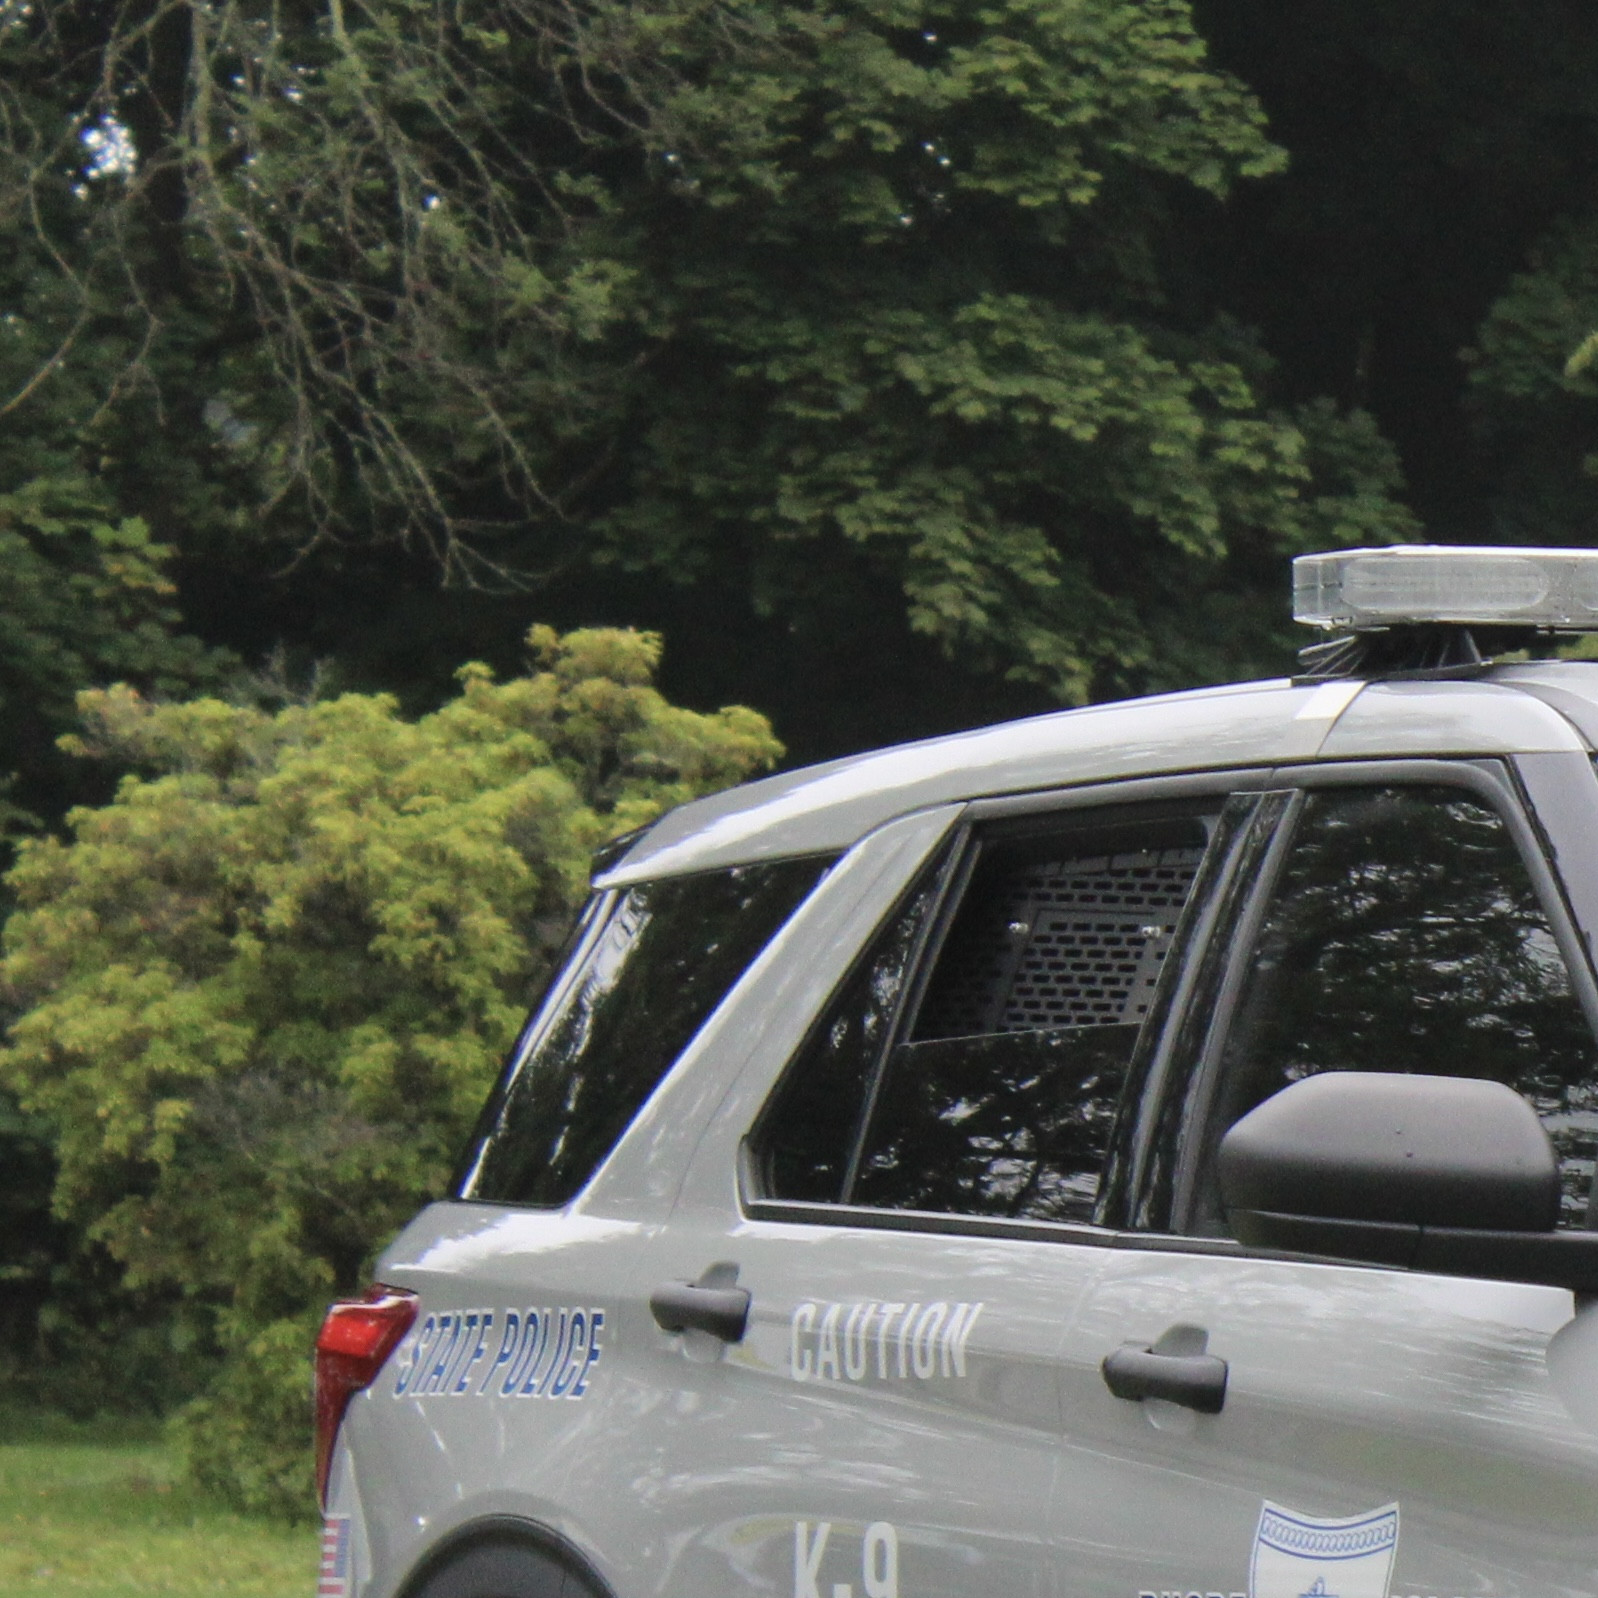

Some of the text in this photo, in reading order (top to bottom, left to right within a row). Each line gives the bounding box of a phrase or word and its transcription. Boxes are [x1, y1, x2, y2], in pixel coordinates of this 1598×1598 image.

[393, 1307, 605, 1400] STATE POLICE
[791, 1302, 984, 1381] CAUTION
